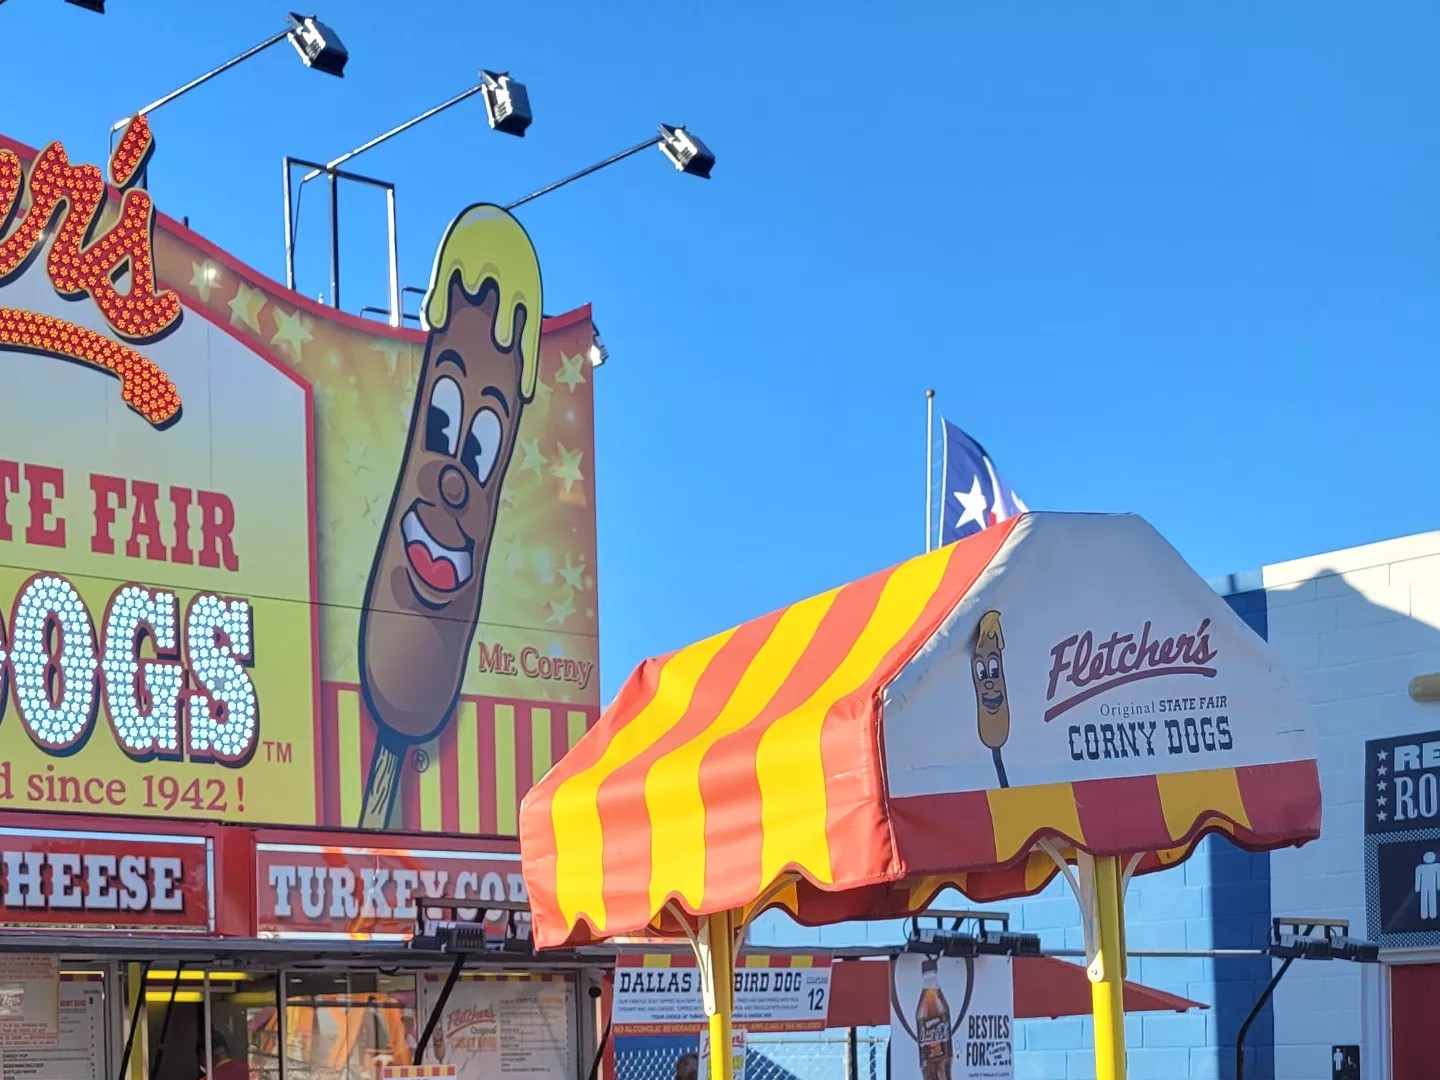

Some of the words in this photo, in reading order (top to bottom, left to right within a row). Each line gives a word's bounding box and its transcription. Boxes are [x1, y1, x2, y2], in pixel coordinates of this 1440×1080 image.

[90, 473, 240, 573] FAIR
[478, 641, 518, 677] Mr.
[520, 646, 594, 689] Corny
[1046, 617, 1218, 701] Fletcher's
[1099, 702, 1156, 718] Original
[1159, 698, 1197, 713] STATE
[1199, 695, 1228, 711] FAIR
[1068, 719, 1157, 762] CORNY
[1164, 716, 1233, 756] DOGS
[26, 765, 127, 808] since
[140, 773, 247, 814] 1942!
[1393, 772, 1440, 822] RO
[269, 864, 449, 921] TURKEY
[454, 871, 531, 921] COR
[619, 970, 692, 993] DALLAS
[734, 972, 770, 992] BIRD
[772, 972, 802, 992] DOG
[807, 988, 825, 1011] 12
[968, 1014, 1010, 1039] BESTIES
